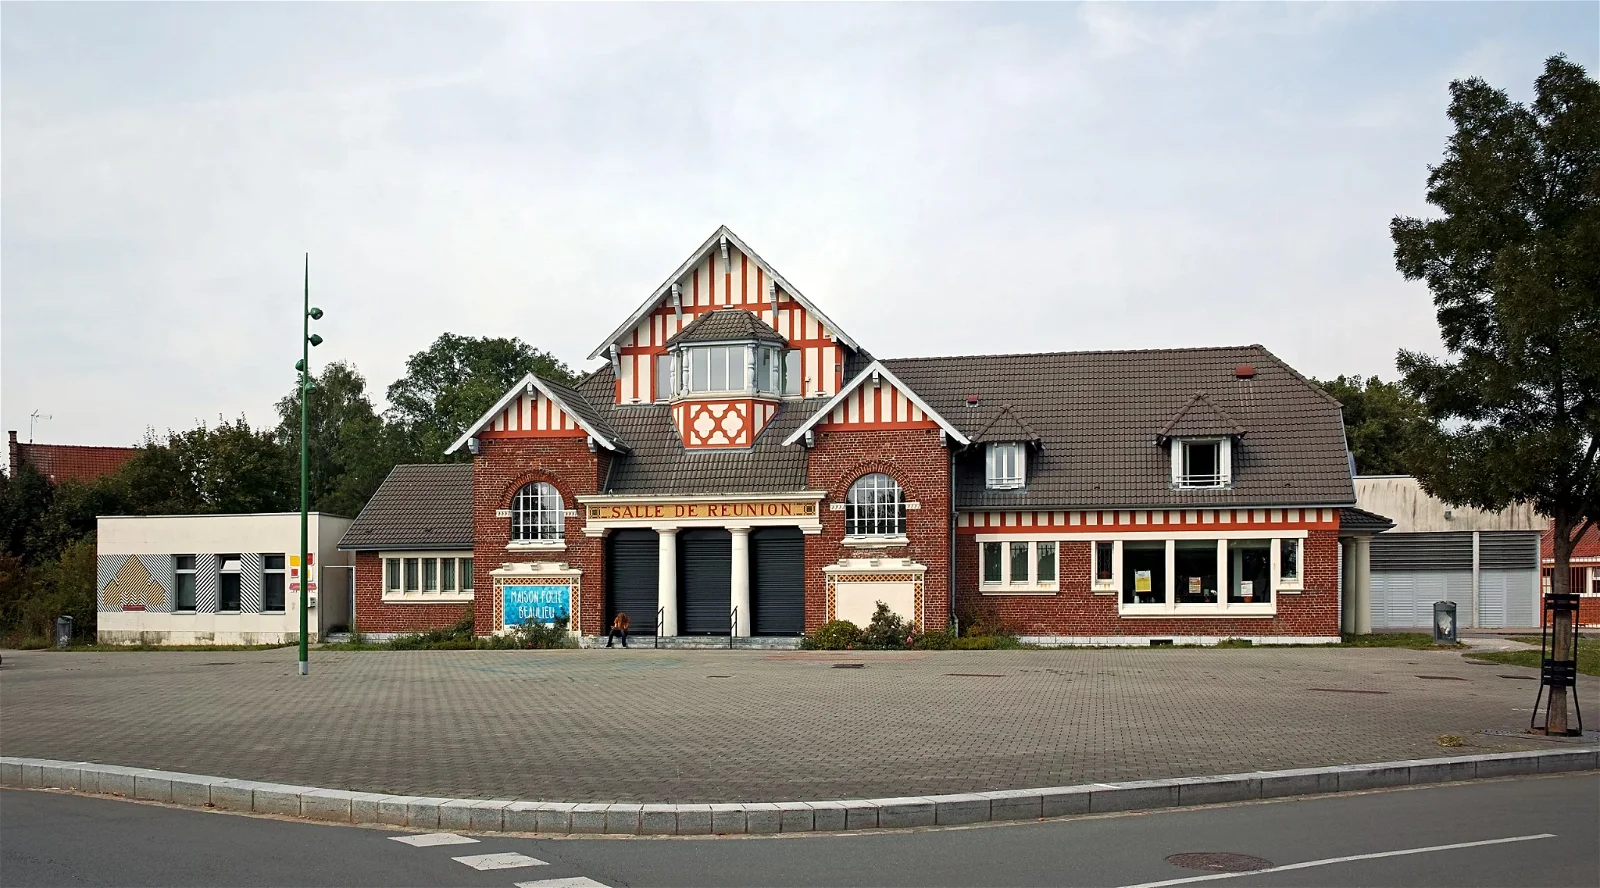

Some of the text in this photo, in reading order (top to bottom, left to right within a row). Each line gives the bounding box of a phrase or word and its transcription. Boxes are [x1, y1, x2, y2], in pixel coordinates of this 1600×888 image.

[611, 504, 664, 518] SALLE
[675, 504, 698, 517] DE
[510, 590, 539, 604] MAISON
[518, 605, 555, 619] BEAULIEU
